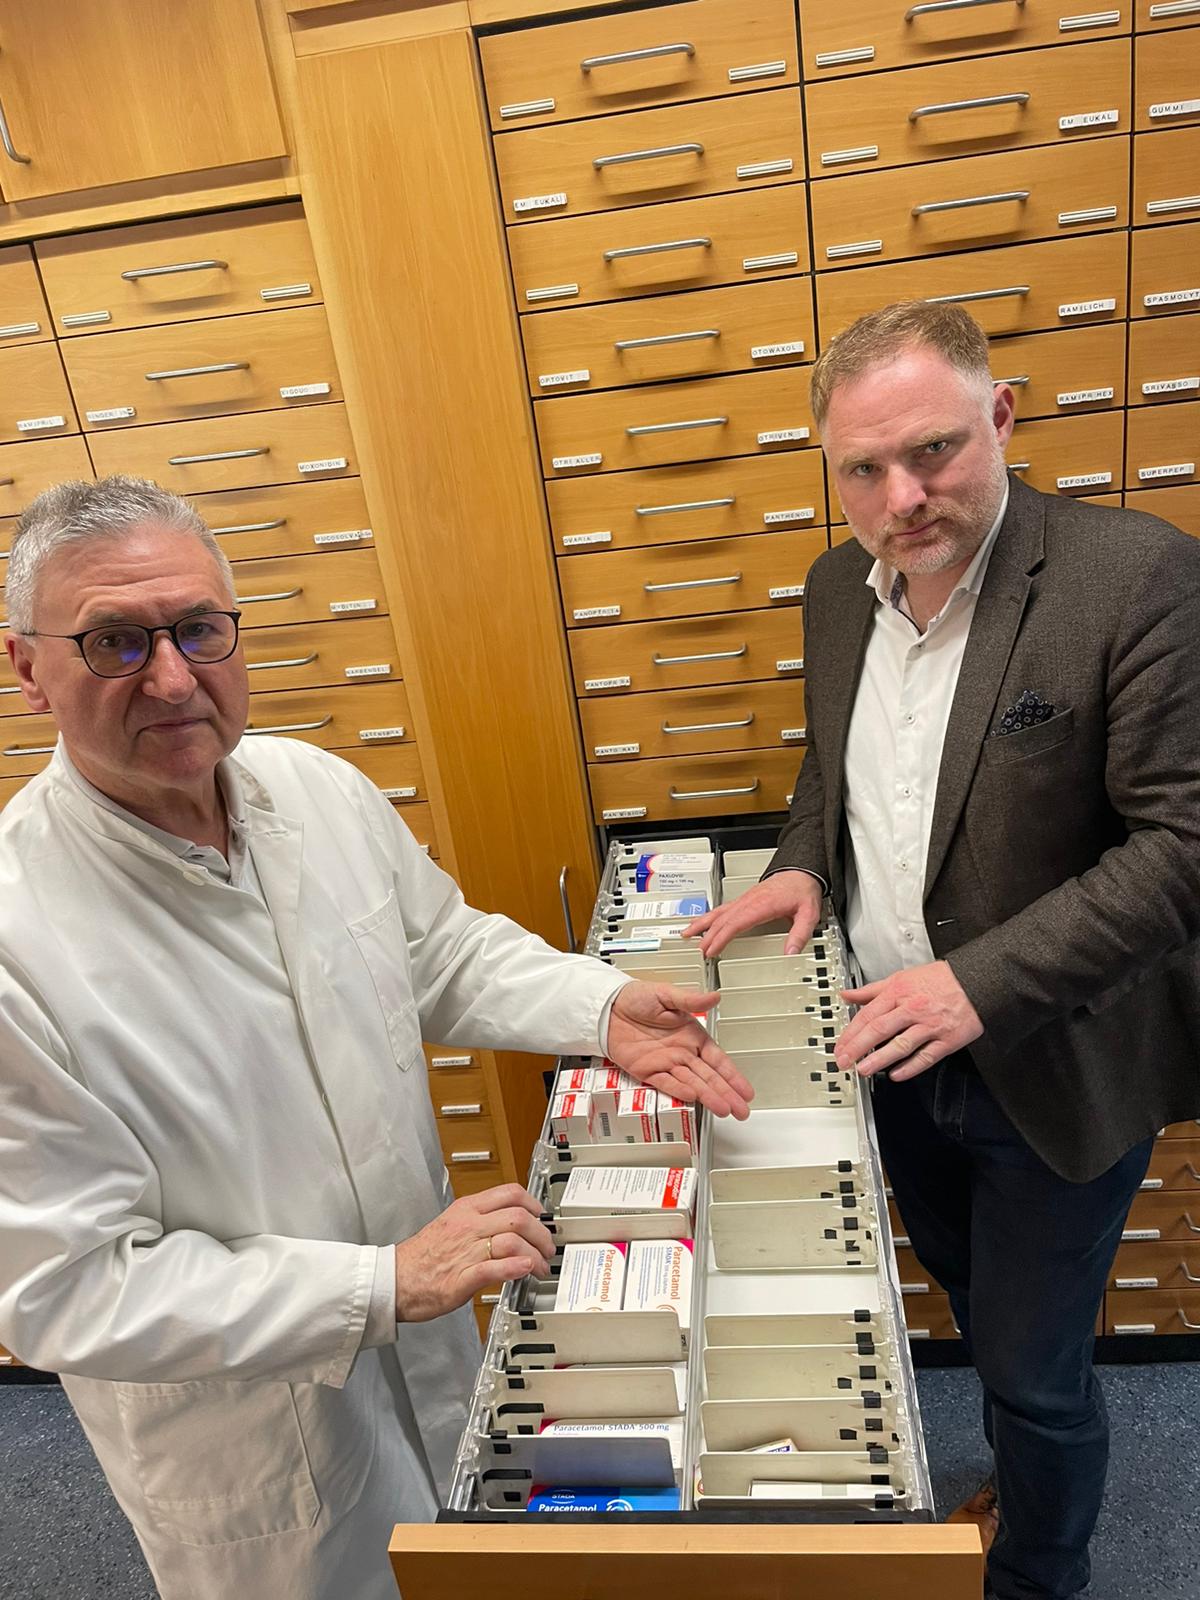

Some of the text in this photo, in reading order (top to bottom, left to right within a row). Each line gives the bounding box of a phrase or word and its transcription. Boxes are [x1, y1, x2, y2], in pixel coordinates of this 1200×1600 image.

[1151, 104, 1184, 114] GUMMI
[1083, 113, 1113, 123] EUKAL
[534, 195, 561, 206] EUKAL
[1146, 291, 1200, 304] SPASMOLYT
[1059, 302, 1105, 313] RAMILICH
[752, 345, 796, 356] OTOWAXOL
[540, 374, 574, 384] OPTOVIT
[1144, 381, 1189, 392] SRIVASSO
[1059, 391, 1112, 403] RAMIPR HEX
[759, 432, 793, 442] OTRIVEN
[299, 461, 341, 470] MOXONIDIN
[1140, 466, 1185, 478] SUPERPEP
[1058, 475, 1106, 486] REFOBACIN
[765, 511, 809, 521] PANTHENOL
[600, 1249, 616, 1303] Paracetamol
[671, 1246, 684, 1300] Paracetamol
[554, 1424, 606, 1432] Paracetamol
[657, 1423, 670, 1431] mg
[539, 1503, 597, 1512] Paracetamol
